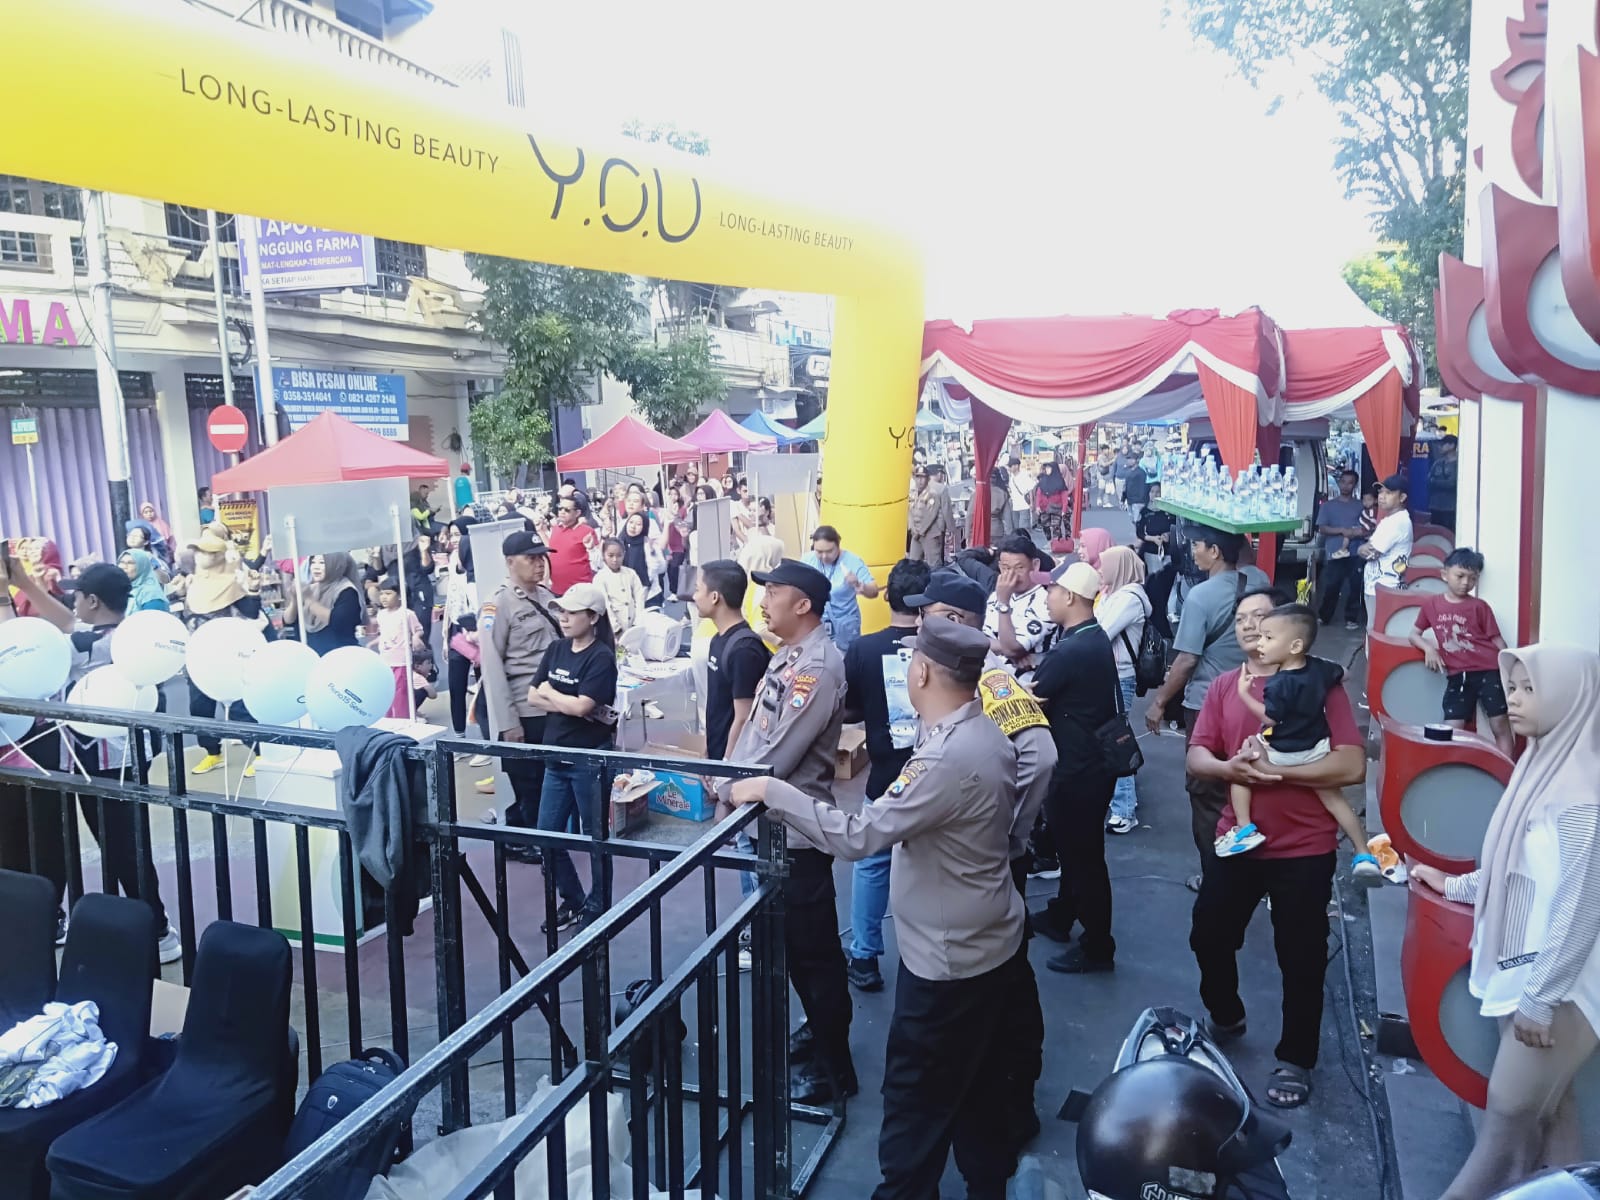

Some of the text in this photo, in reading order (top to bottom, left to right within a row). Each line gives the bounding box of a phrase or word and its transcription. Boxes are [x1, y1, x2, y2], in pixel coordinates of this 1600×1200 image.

[180, 67, 500, 174] LONG-LASTING BEAUTY
[526, 132, 702, 243] Y.O.U
[719, 210, 854, 250] LONG-LASTING BEAUTY
[316, 236, 359, 252] FARMA
[290, 371, 378, 391] BISA PESAN ONLINE
[655, 792, 691, 810] Minerale
[667, 785, 678, 799] Le
